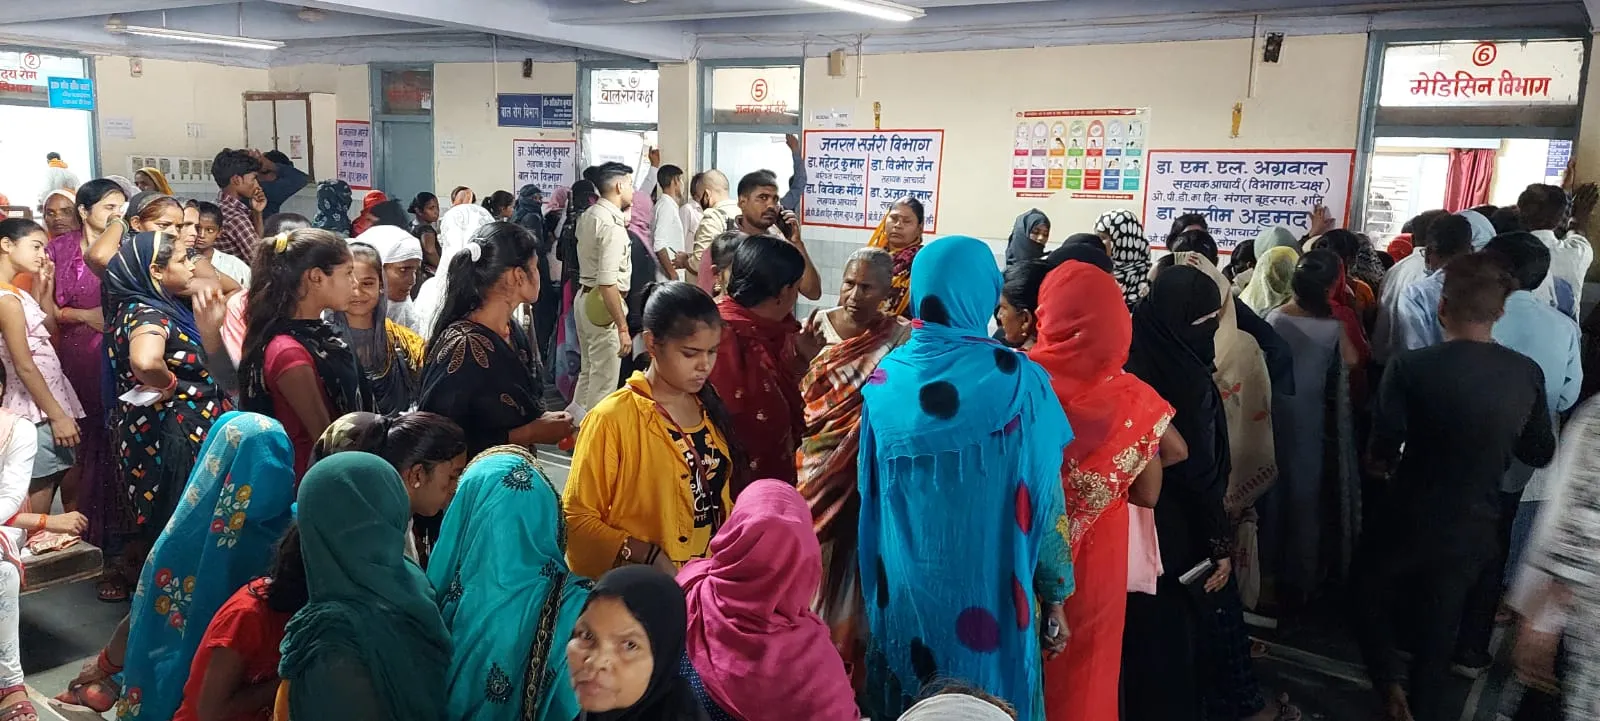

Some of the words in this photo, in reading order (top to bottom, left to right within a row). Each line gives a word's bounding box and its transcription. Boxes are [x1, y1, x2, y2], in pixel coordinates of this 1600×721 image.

[1478, 47, 1490, 61] 6
[0, 69, 18, 80] दय
[19, 66, 38, 80] रोग
[755, 83, 764, 98] 5
[1410, 70, 1494, 97] मेडिसिन
[1497, 69, 1552, 96] विभाग
[601, 89, 620, 103] बाल
[500, 106, 512, 118] बाल
[512, 104, 522, 119] रोग
[523, 103, 539, 119] विभाग
[820, 138, 856, 152] जनरल
[857, 134, 888, 152] सर्जरी
[889, 134, 933, 152] विभाग
[552, 146, 571, 160] कुमार
[807, 156, 818, 168] डा.
[818, 154, 841, 172] महेन्द्र
[841, 158, 865, 172] कुमार
[871, 158, 885, 171] डा.
[885, 155, 914, 172] विभोर
[915, 155, 935, 172] जैन
[1156, 160, 1175, 175] डा.
[1180, 160, 1213, 175] एम.
[1216, 160, 1249, 176] एल.
[1253, 160, 1329, 177] अग्रवाल
[880, 175, 902, 185] सहायक
[903, 173, 927, 185] आचार्य
[1172, 180, 1210, 191] सहायक
[1210, 177, 1241, 191] आचार्य
[805, 183, 817, 194] डा.
[818, 181, 846, 195] विवेक
[846, 183, 865, 196] मौर्य
[870, 187, 882, 199] डा.
[883, 187, 907, 200] अजय
[907, 189, 934, 203] कमार
[1223, 192, 1253, 205] मंगल
[1239, 209, 1311, 230] अहमद
[1224, 225, 1262, 238] आचार्य
